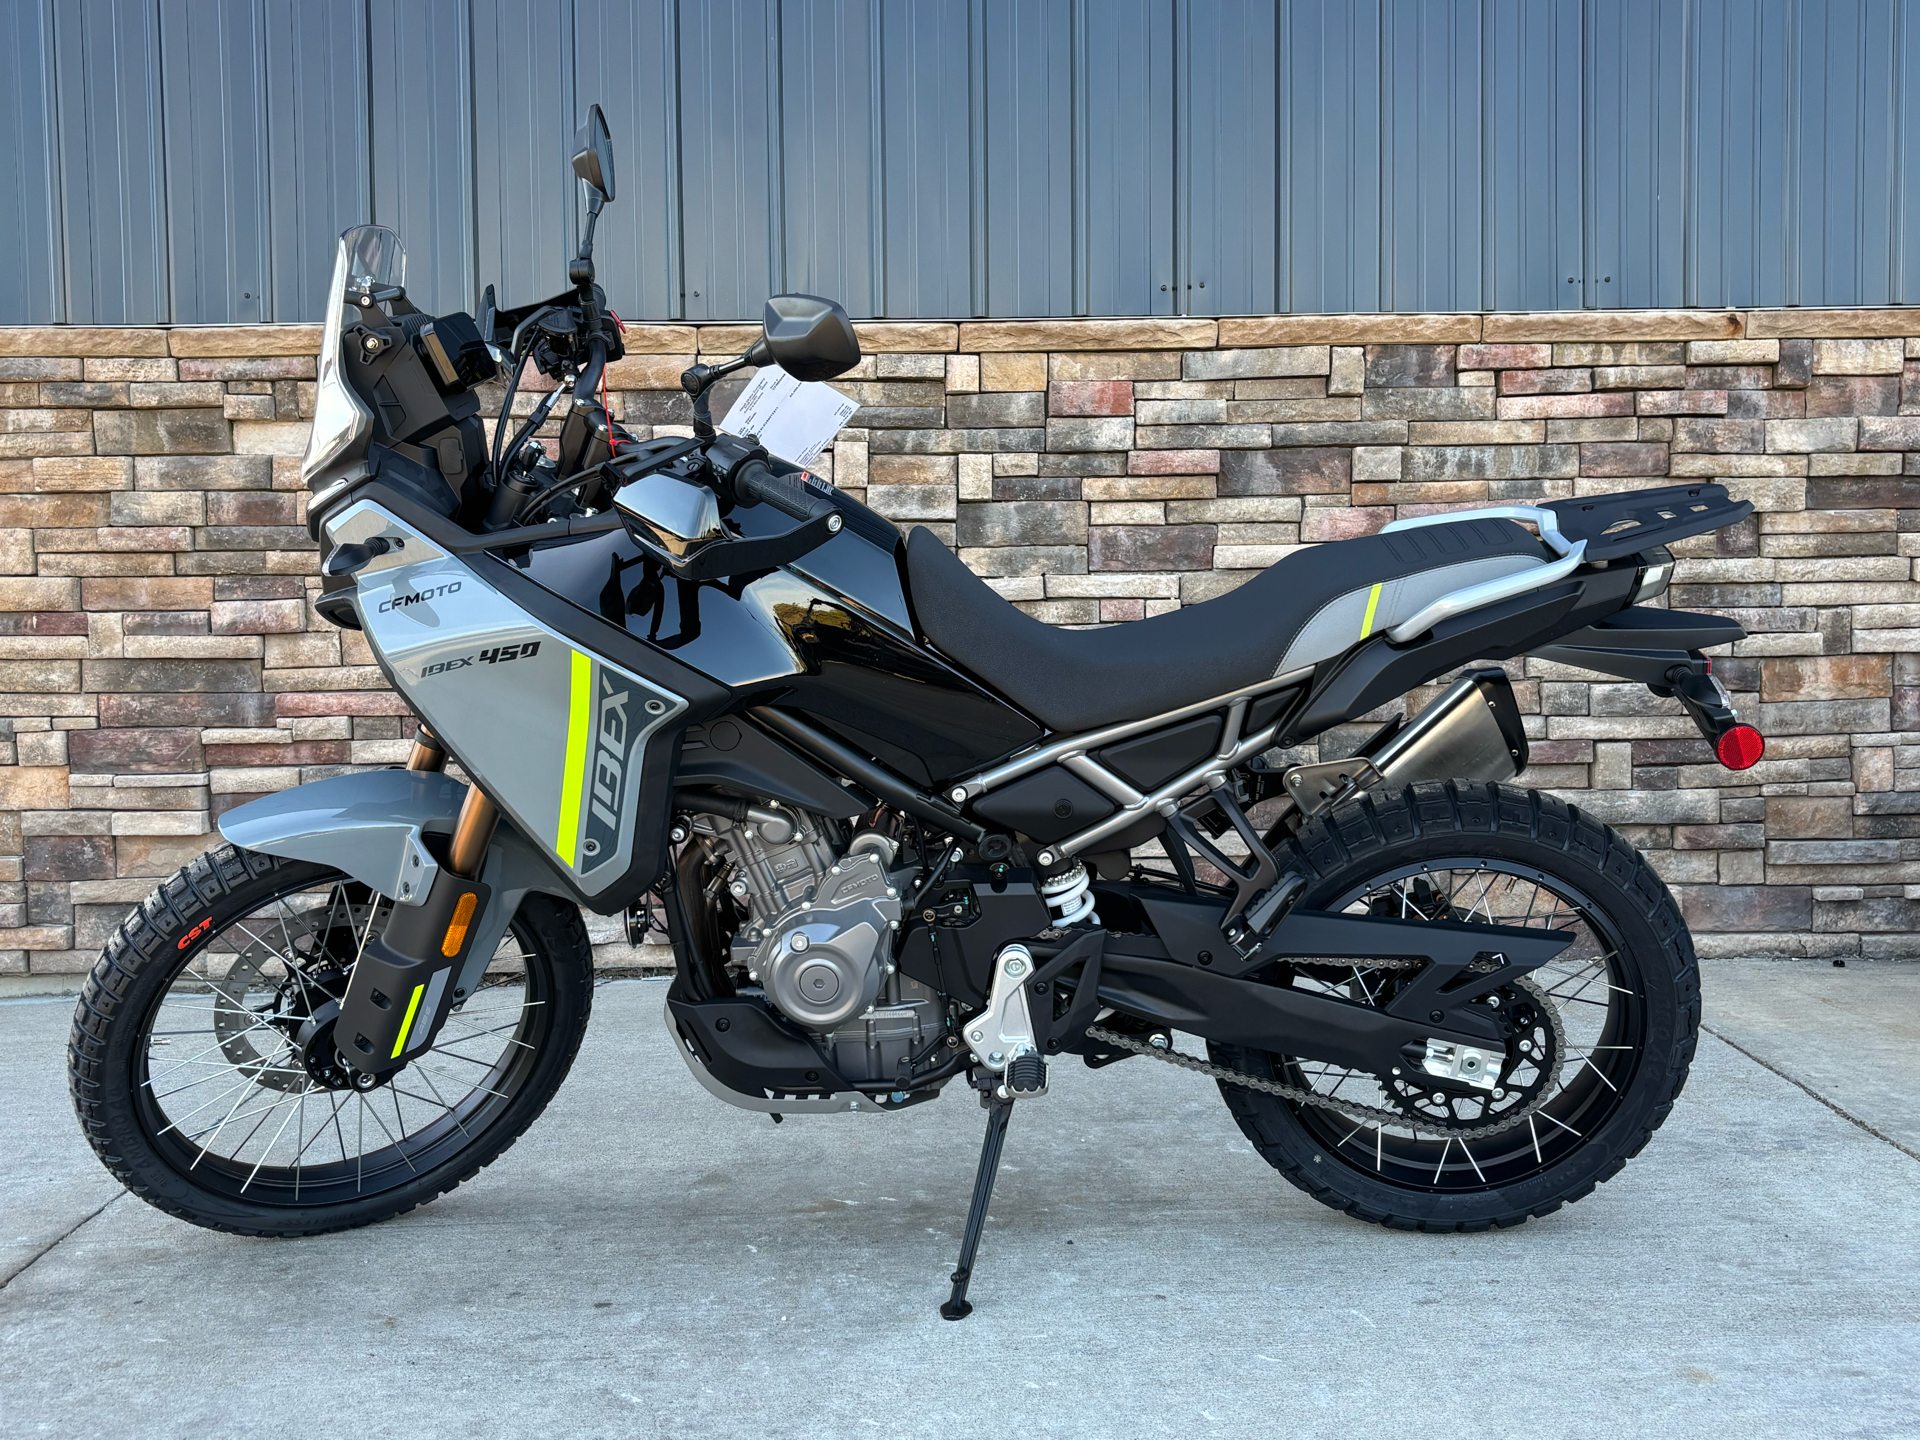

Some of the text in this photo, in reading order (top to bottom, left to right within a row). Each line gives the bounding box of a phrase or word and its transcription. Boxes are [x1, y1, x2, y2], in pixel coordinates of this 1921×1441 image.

[378, 581, 462, 614] CFMOTO
[420, 641, 542, 679] IBEX 450
[591, 672, 629, 831] IBEX
[840, 874, 879, 895] CFMOTO
[177, 916, 213, 950] CST
[418, 1005, 432, 1035] ABS
[110, 1111, 157, 1169] AMBRO
[149, 1168, 170, 1188] RIDE
